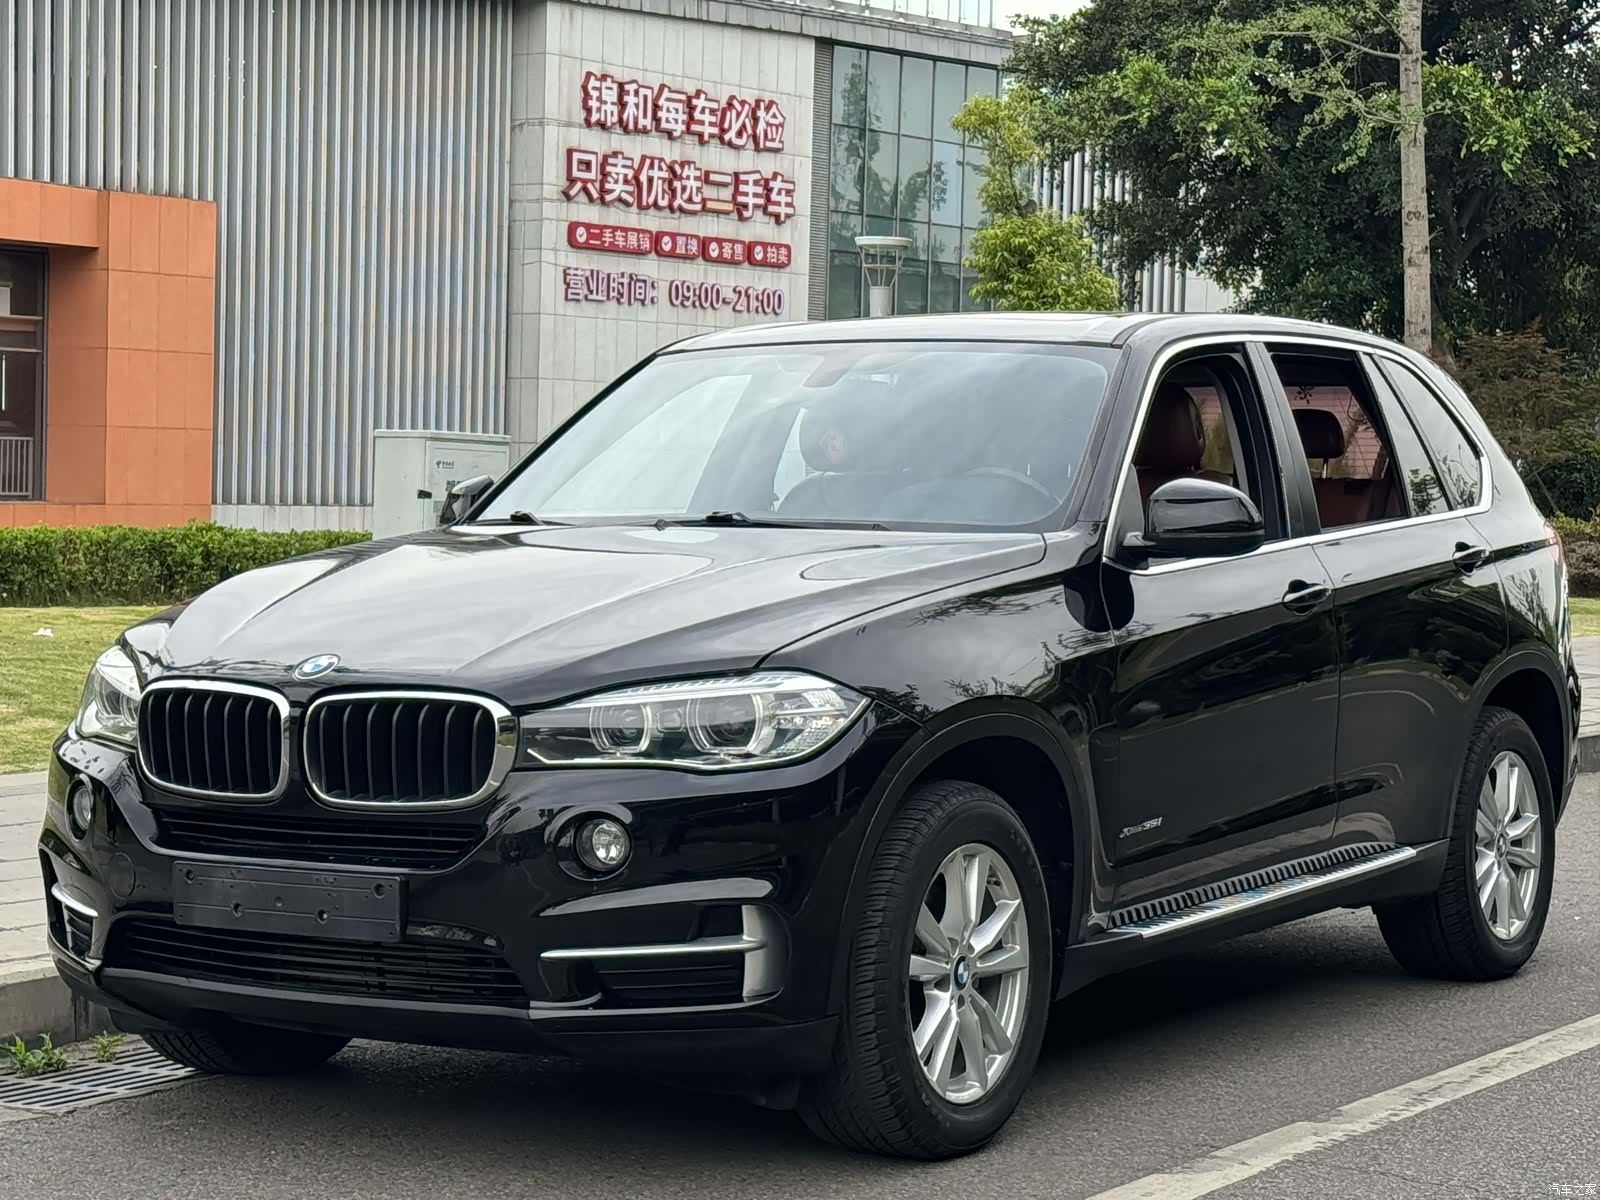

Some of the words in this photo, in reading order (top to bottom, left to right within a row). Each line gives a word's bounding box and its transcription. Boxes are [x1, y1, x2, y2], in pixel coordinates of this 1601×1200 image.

[583, 72, 786, 151] 锦和每车必检
[562, 149, 796, 224] 只卖优选二手车
[588, 228, 651, 251] 二手车展销
[675, 236, 699, 255] 置换
[721, 242, 744, 262] 寄售
[766, 245, 789, 265] 拍卖
[669, 280, 785, 316] 09:00-21:00
